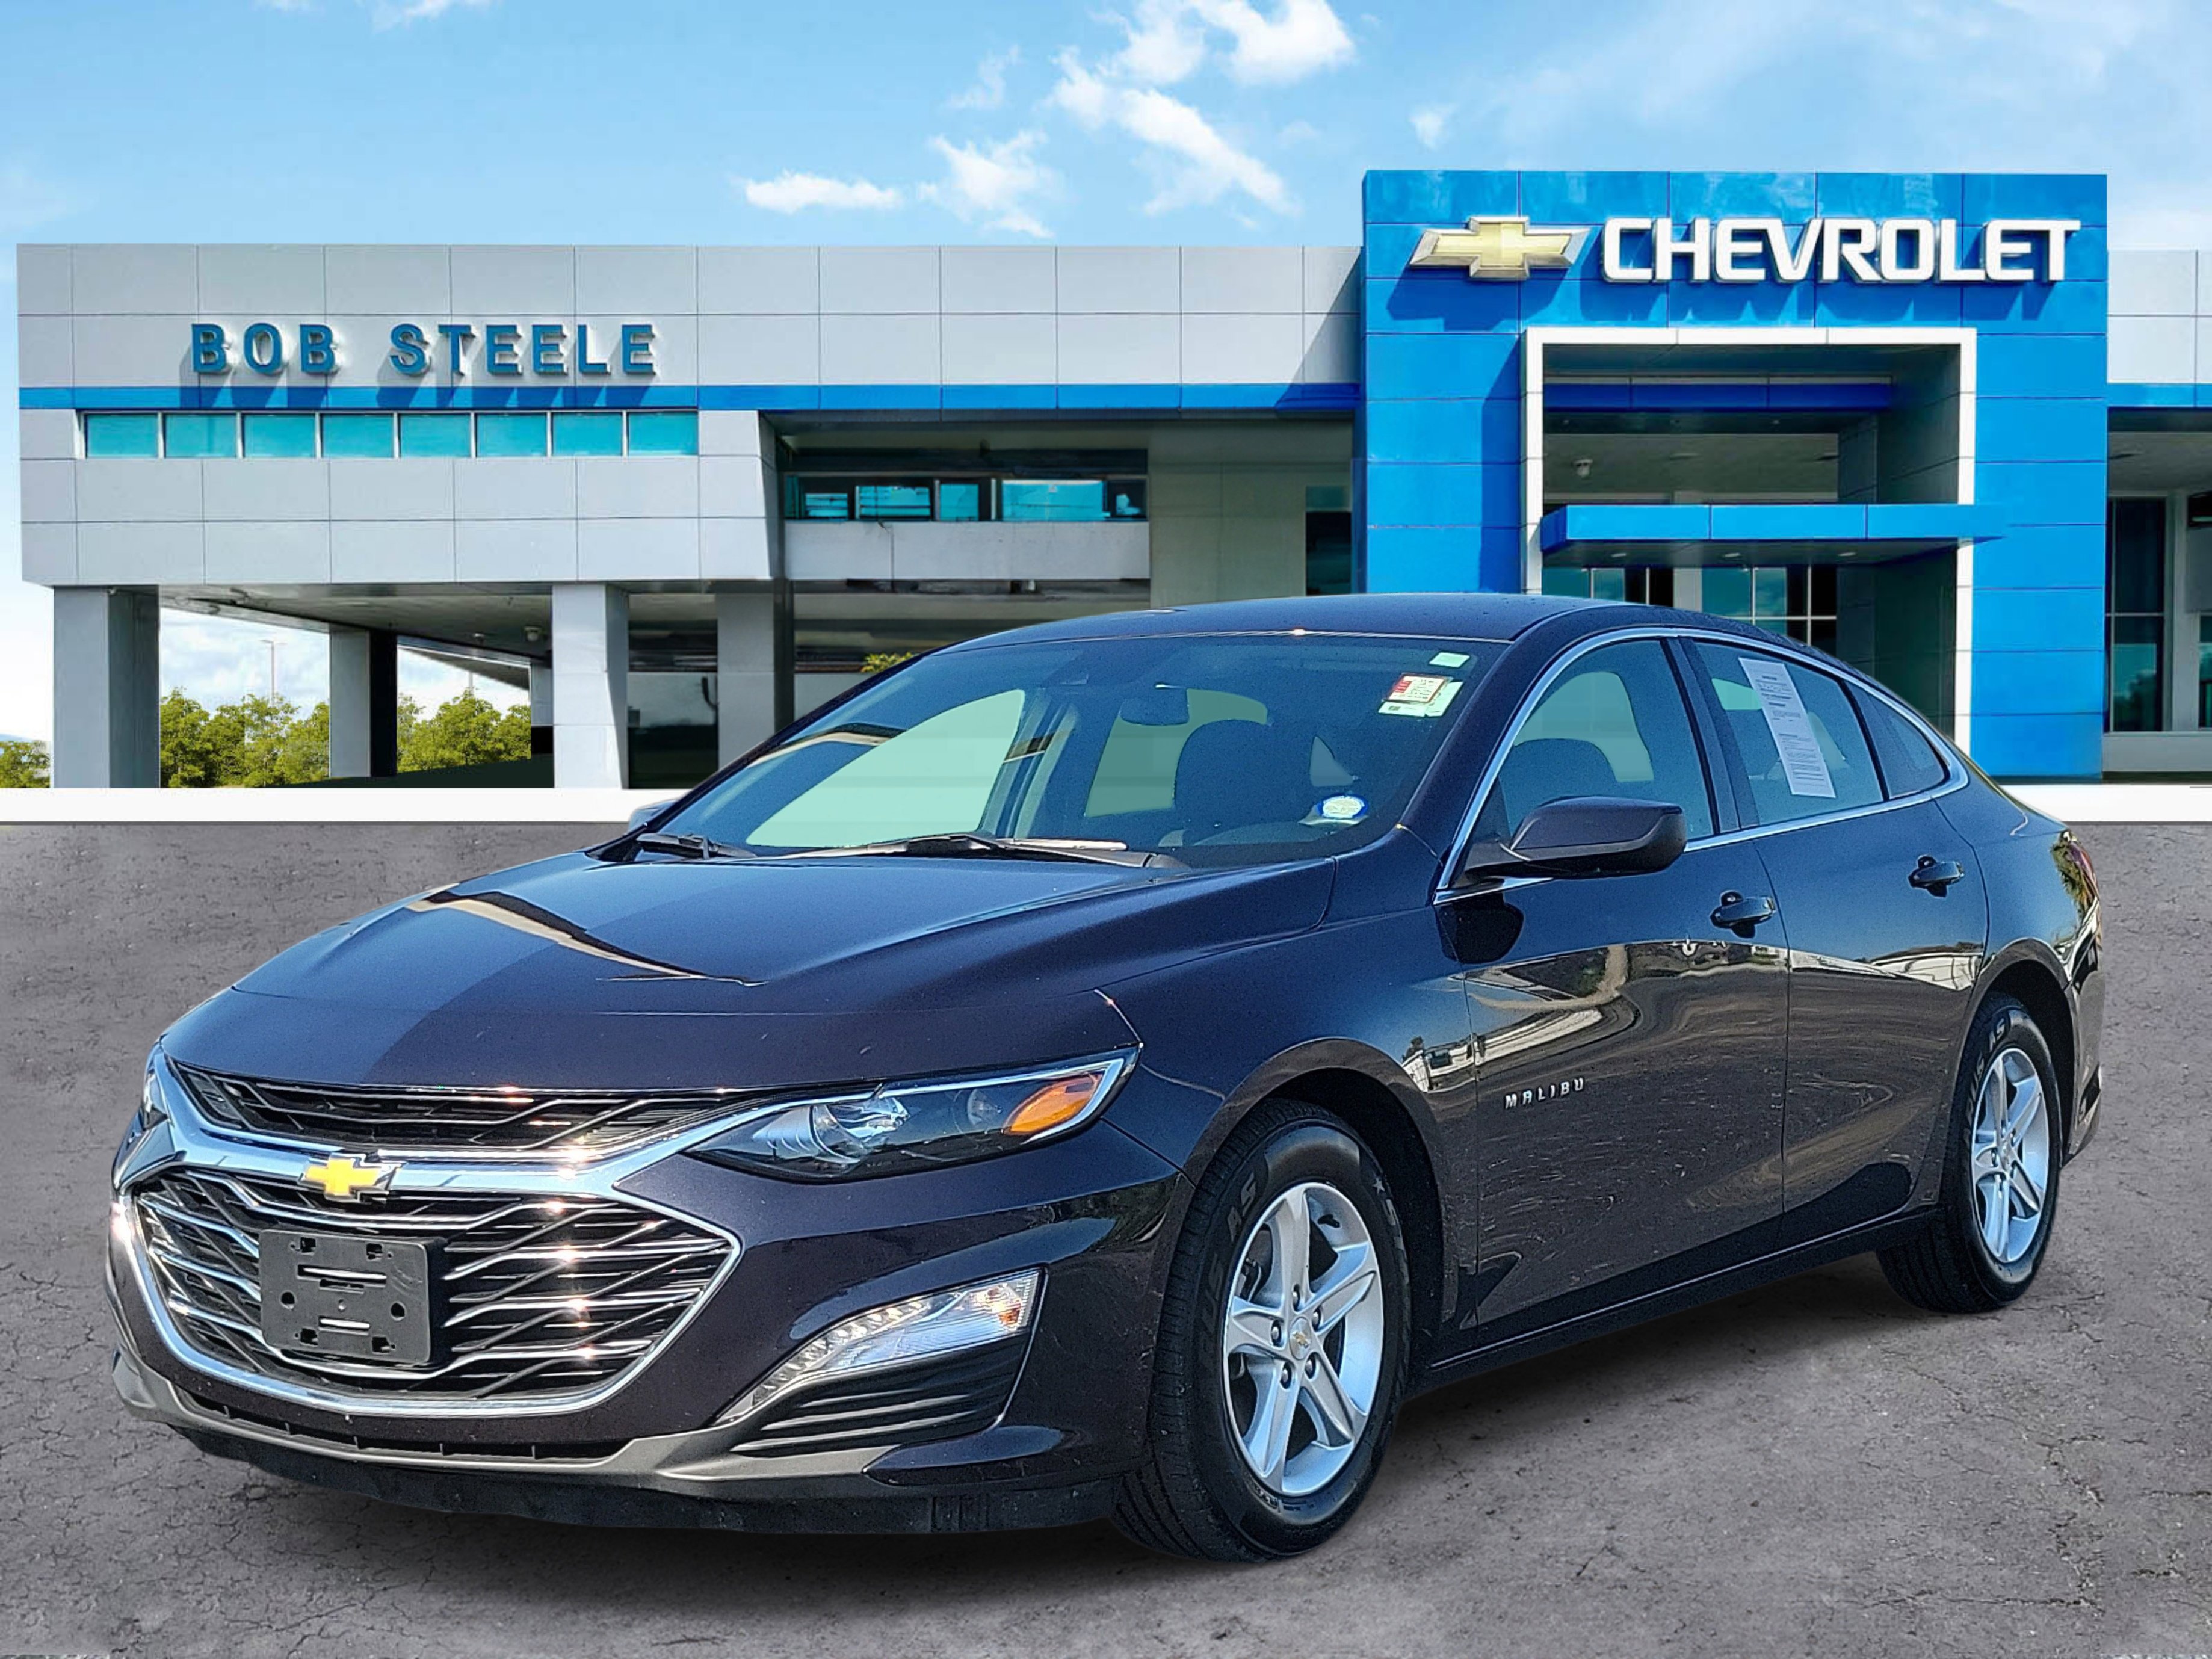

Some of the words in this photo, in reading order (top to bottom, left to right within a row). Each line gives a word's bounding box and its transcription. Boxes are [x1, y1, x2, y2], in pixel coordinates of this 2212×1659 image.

[1601, 217, 2080, 283] CHEVROLET
[191, 323, 338, 375] BOB
[389, 323, 656, 375] STEELE
[1504, 1077, 1585, 1109] MALIBU
